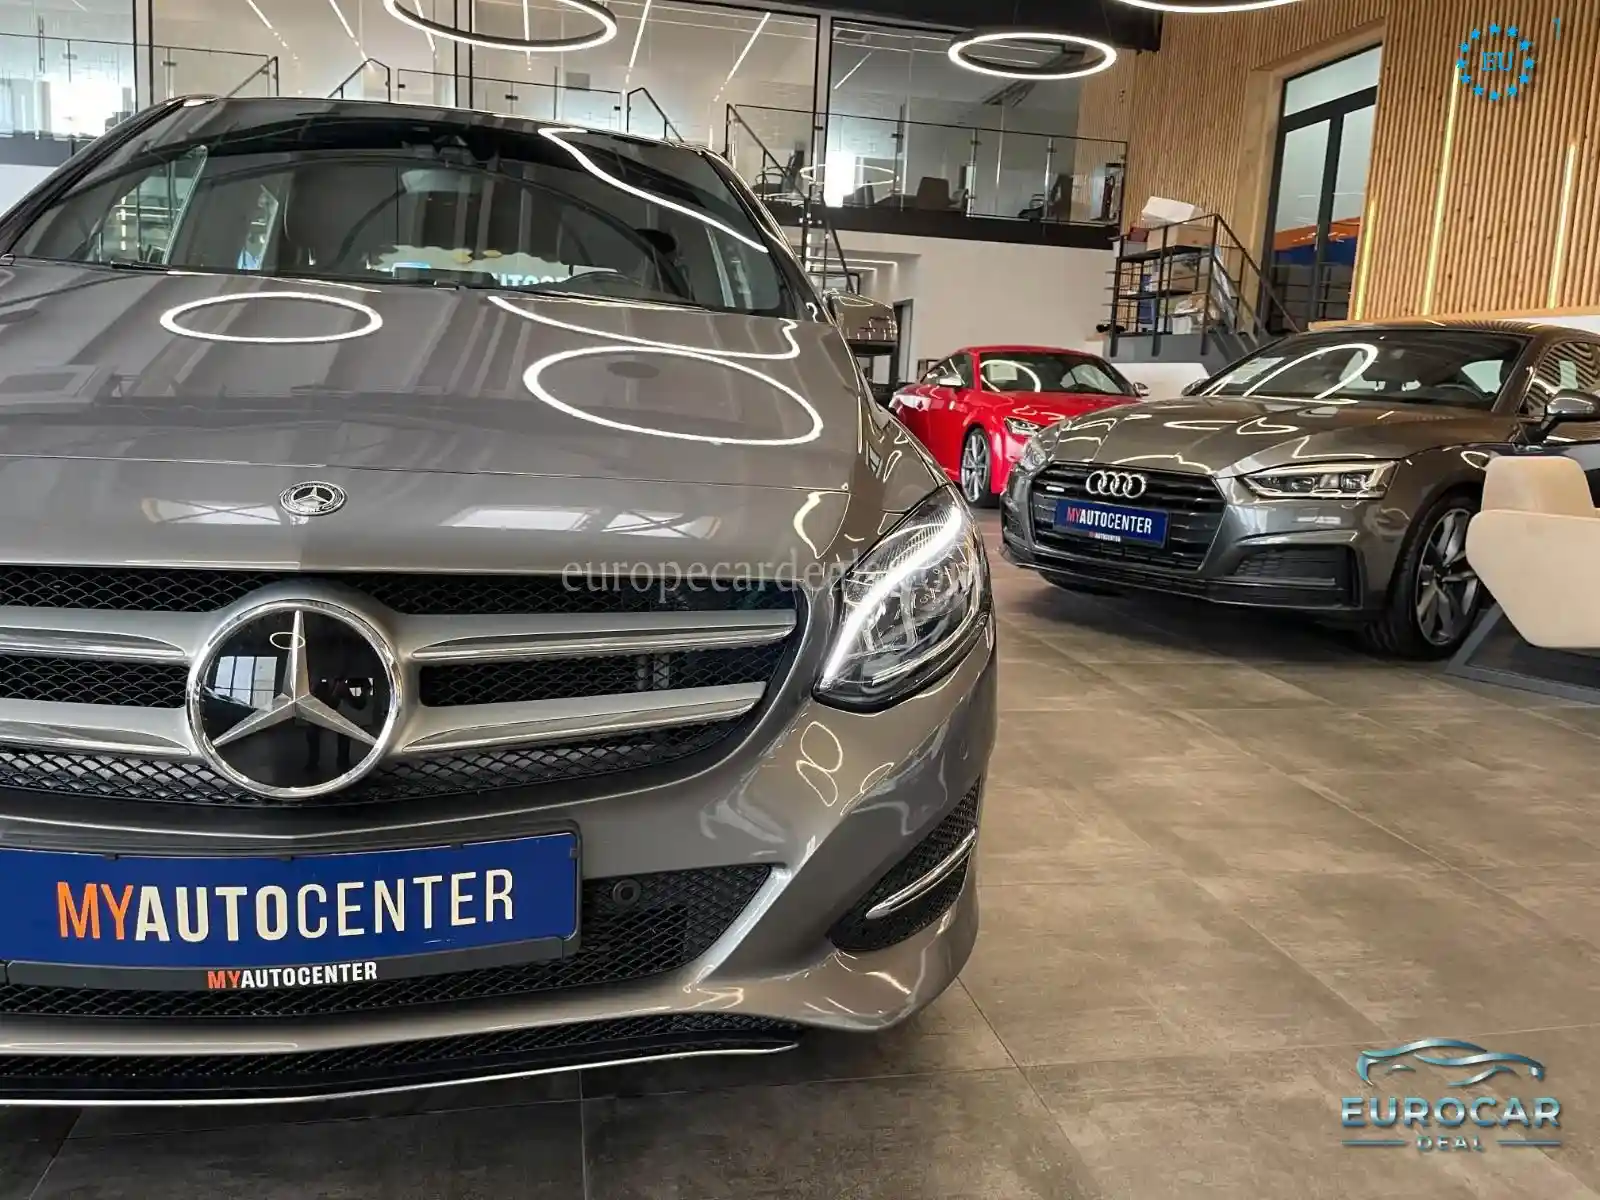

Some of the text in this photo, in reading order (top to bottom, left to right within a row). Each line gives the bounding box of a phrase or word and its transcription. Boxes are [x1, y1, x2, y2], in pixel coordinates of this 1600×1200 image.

[1066, 506, 1153, 534] MYAUTOCENTER
[56, 868, 514, 942] MYAUTOCENTER
[207, 961, 377, 989] MYAUTOCENTER
